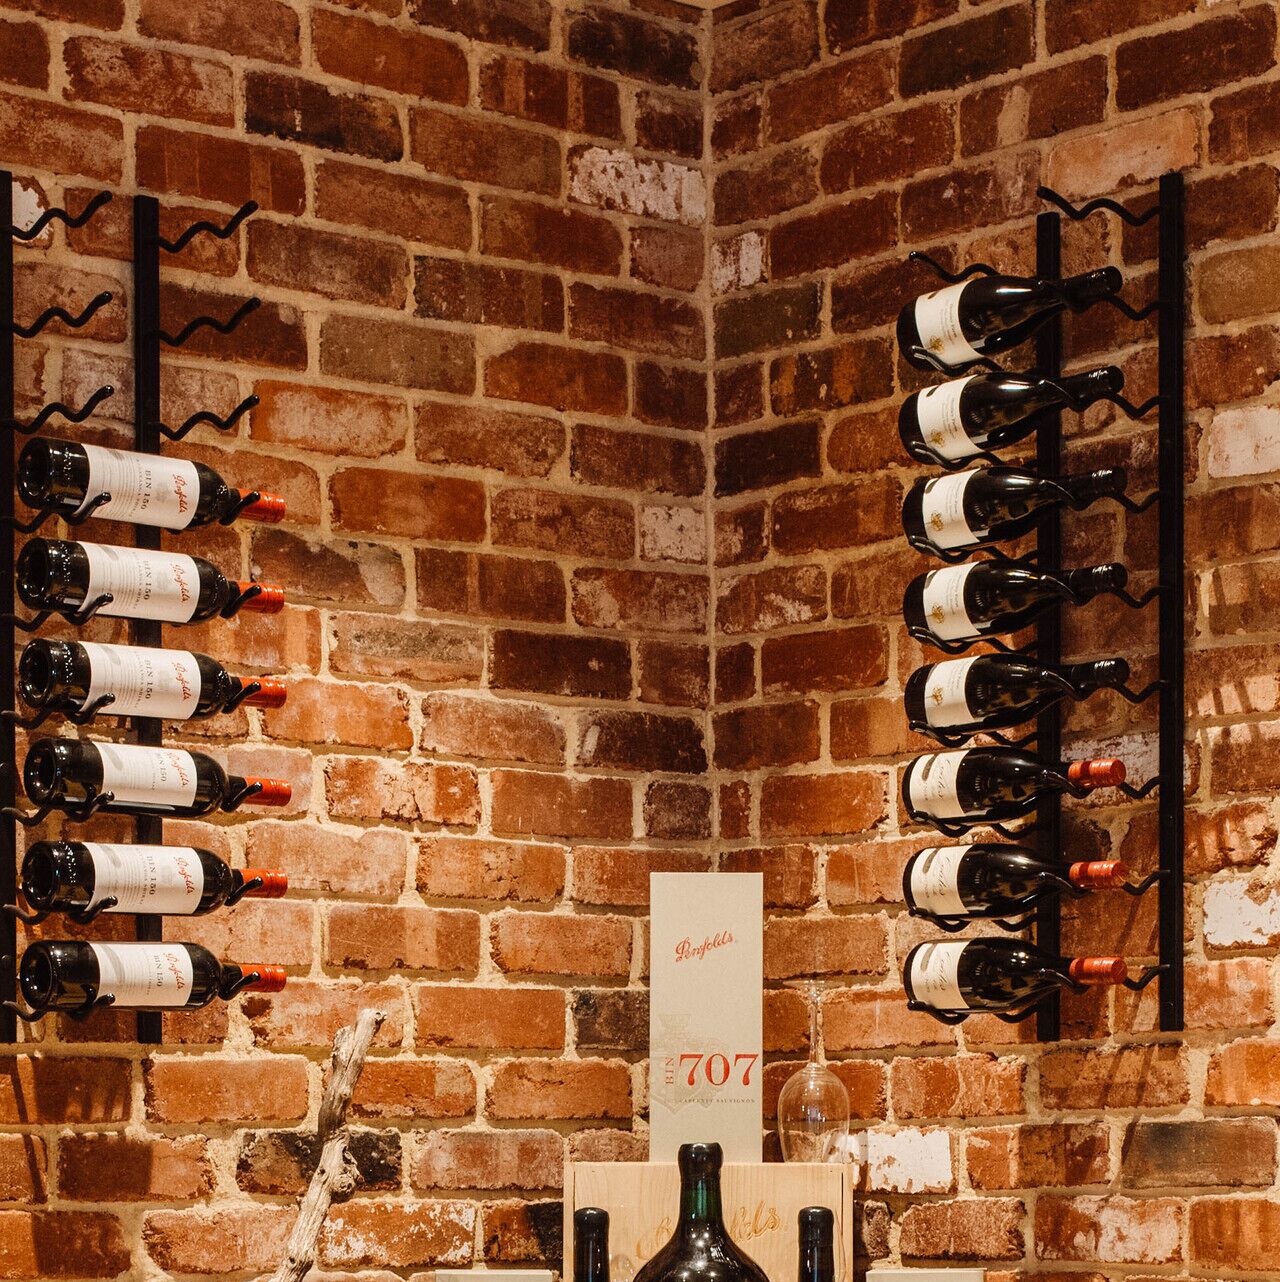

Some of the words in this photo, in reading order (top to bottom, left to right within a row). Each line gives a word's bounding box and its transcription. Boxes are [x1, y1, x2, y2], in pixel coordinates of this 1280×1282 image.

[140, 491, 152, 510] 150
[143, 582, 152, 600] 150
[145, 681, 153, 700] 150
[149, 877, 157, 895] 150
[675, 930, 734, 962] Penfolds
[156, 972, 164, 987] 150
[665, 1057, 674, 1085] BIN
[679, 1053, 759, 1086] 707
